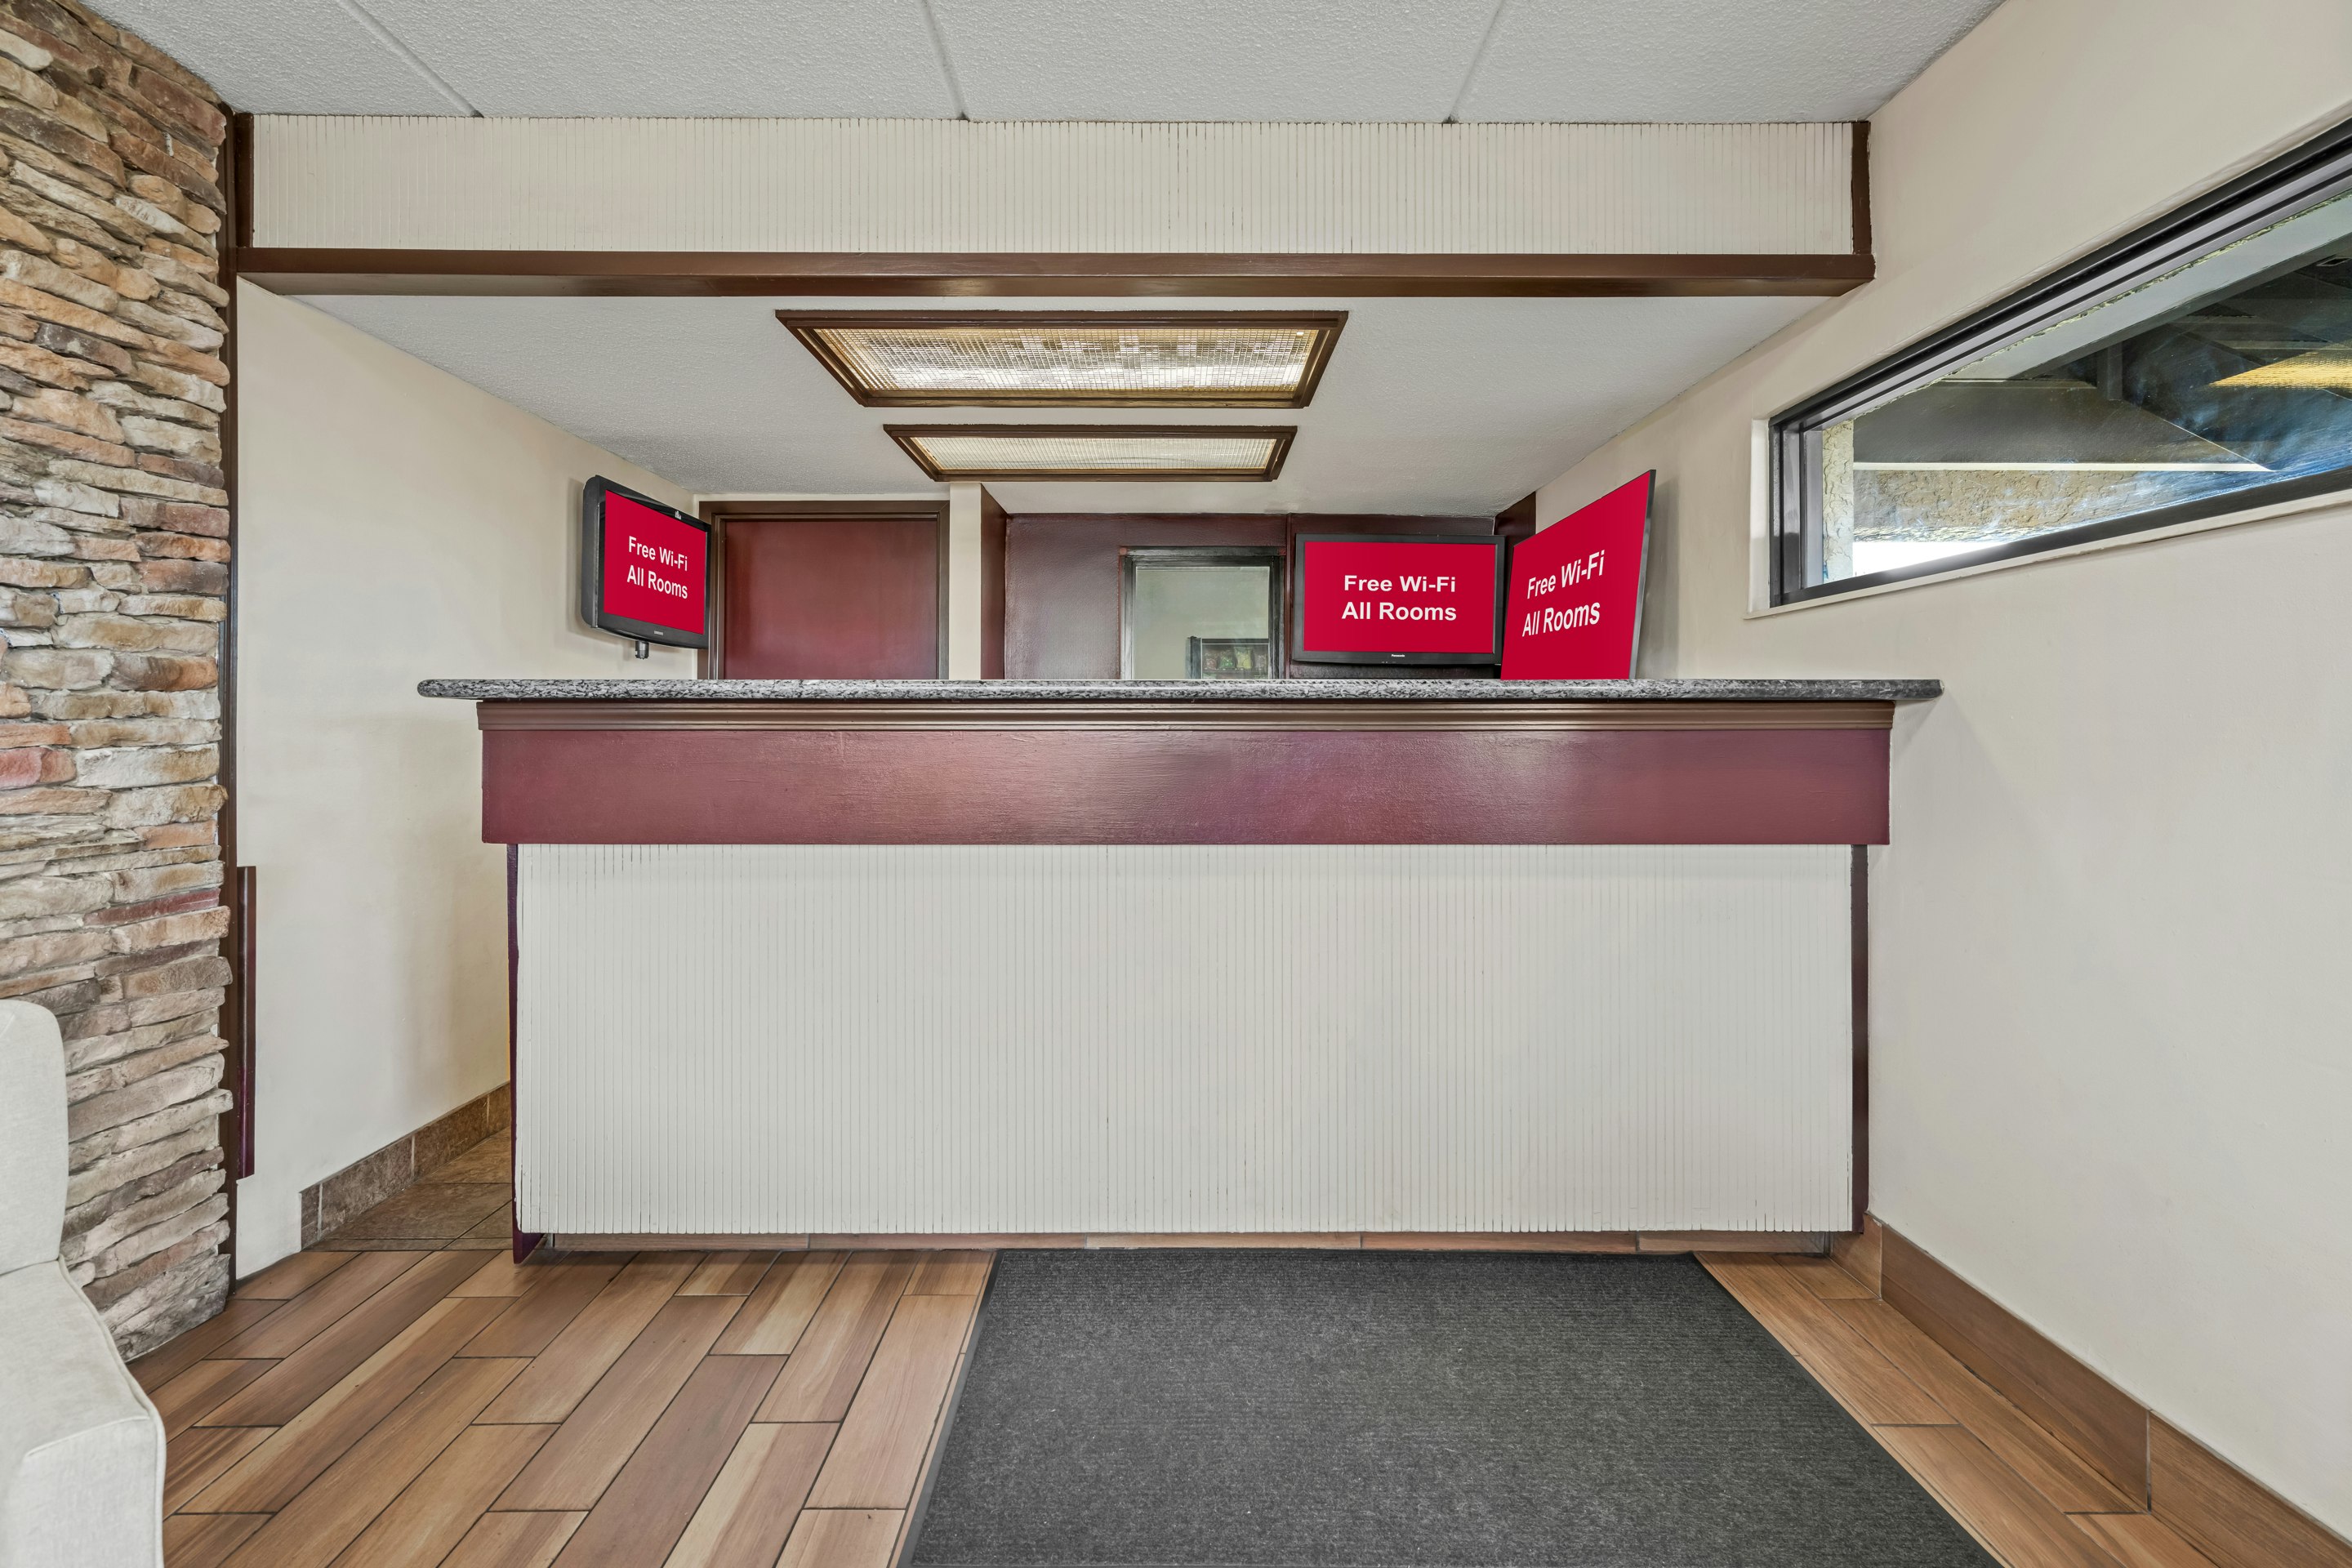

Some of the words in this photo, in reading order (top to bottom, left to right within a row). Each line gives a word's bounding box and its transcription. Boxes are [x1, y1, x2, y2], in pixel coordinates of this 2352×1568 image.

[629, 536, 656, 560] Free
[659, 547, 688, 572] Wi-Fi
[627, 565, 644, 586] All
[648, 571, 688, 599] Rooms
[1344, 575, 1392, 591] Free
[1400, 576, 1455, 592] Wi-Fi
[1527, 574, 1556, 599] Free
[1561, 550, 1605, 588] Wi-Fi
[1342, 602, 1370, 619] All
[1379, 603, 1457, 621] Rooms
[1522, 611, 1541, 637] All
[1544, 602, 1601, 633] Rooms
